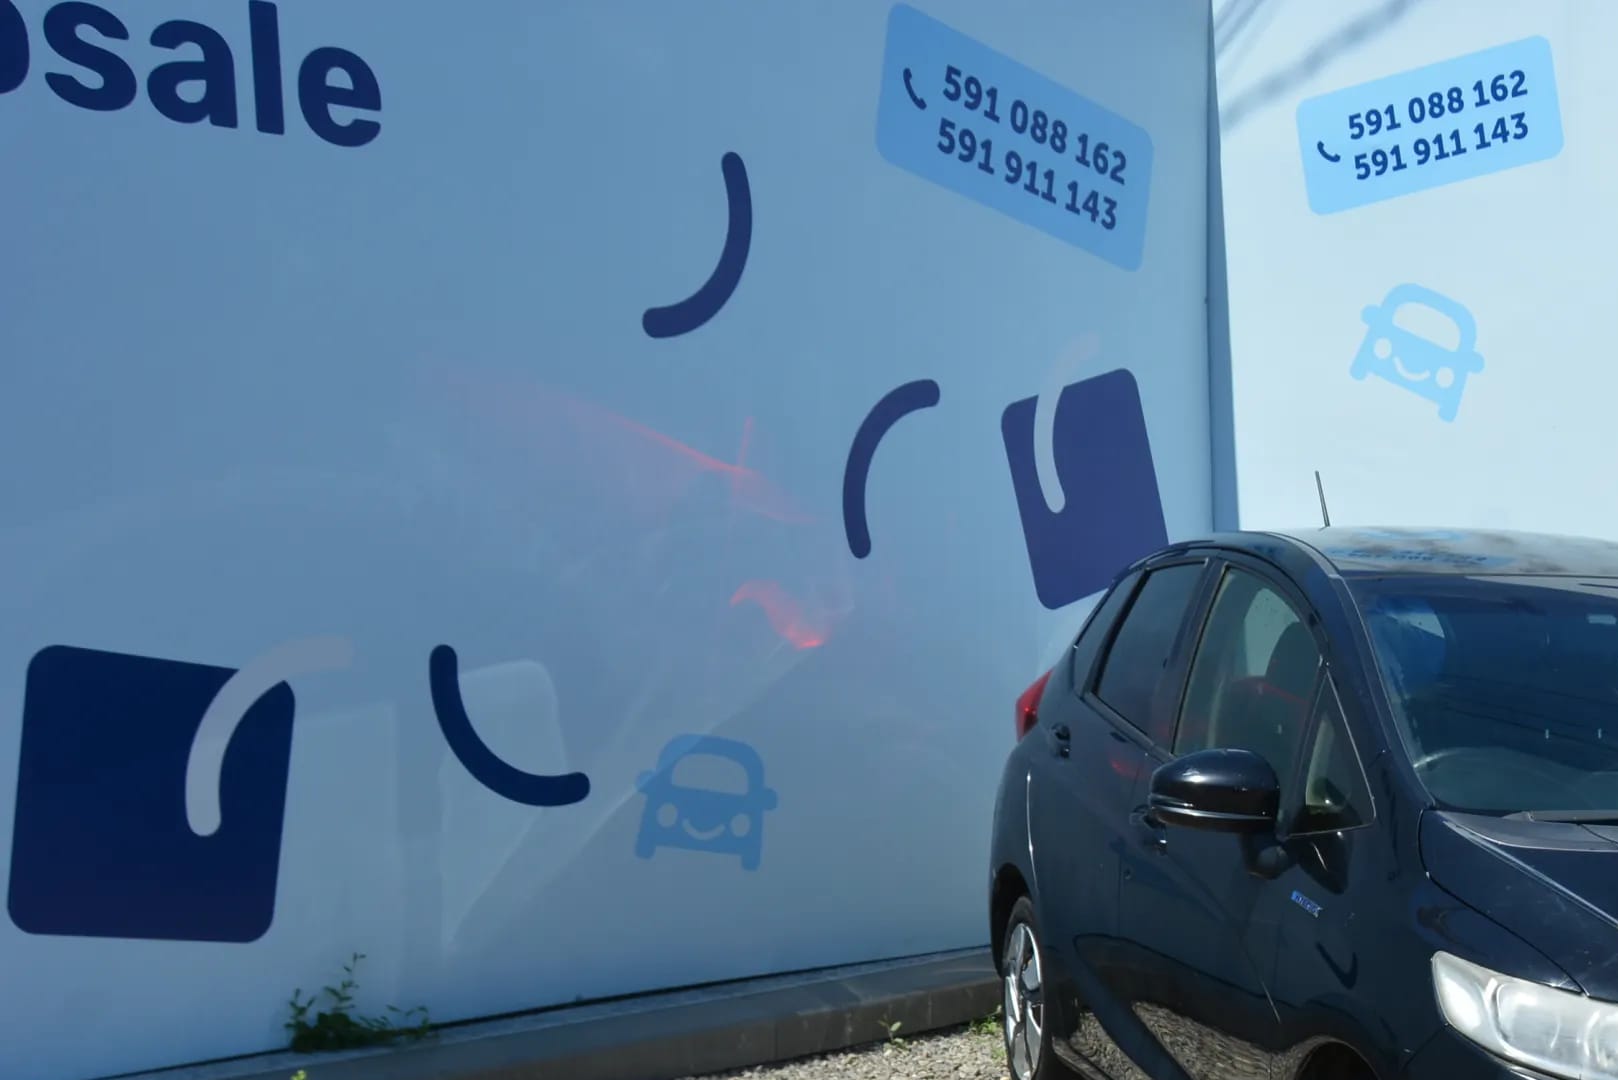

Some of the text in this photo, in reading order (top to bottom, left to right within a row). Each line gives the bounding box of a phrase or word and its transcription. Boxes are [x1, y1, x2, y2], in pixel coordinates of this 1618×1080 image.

[942, 64, 1127, 186] 591 088 162
[1348, 69, 1528, 141] 591 088 162
[1354, 111, 1529, 181] 591 911 143
[937, 117, 1118, 231] 591 911 143
